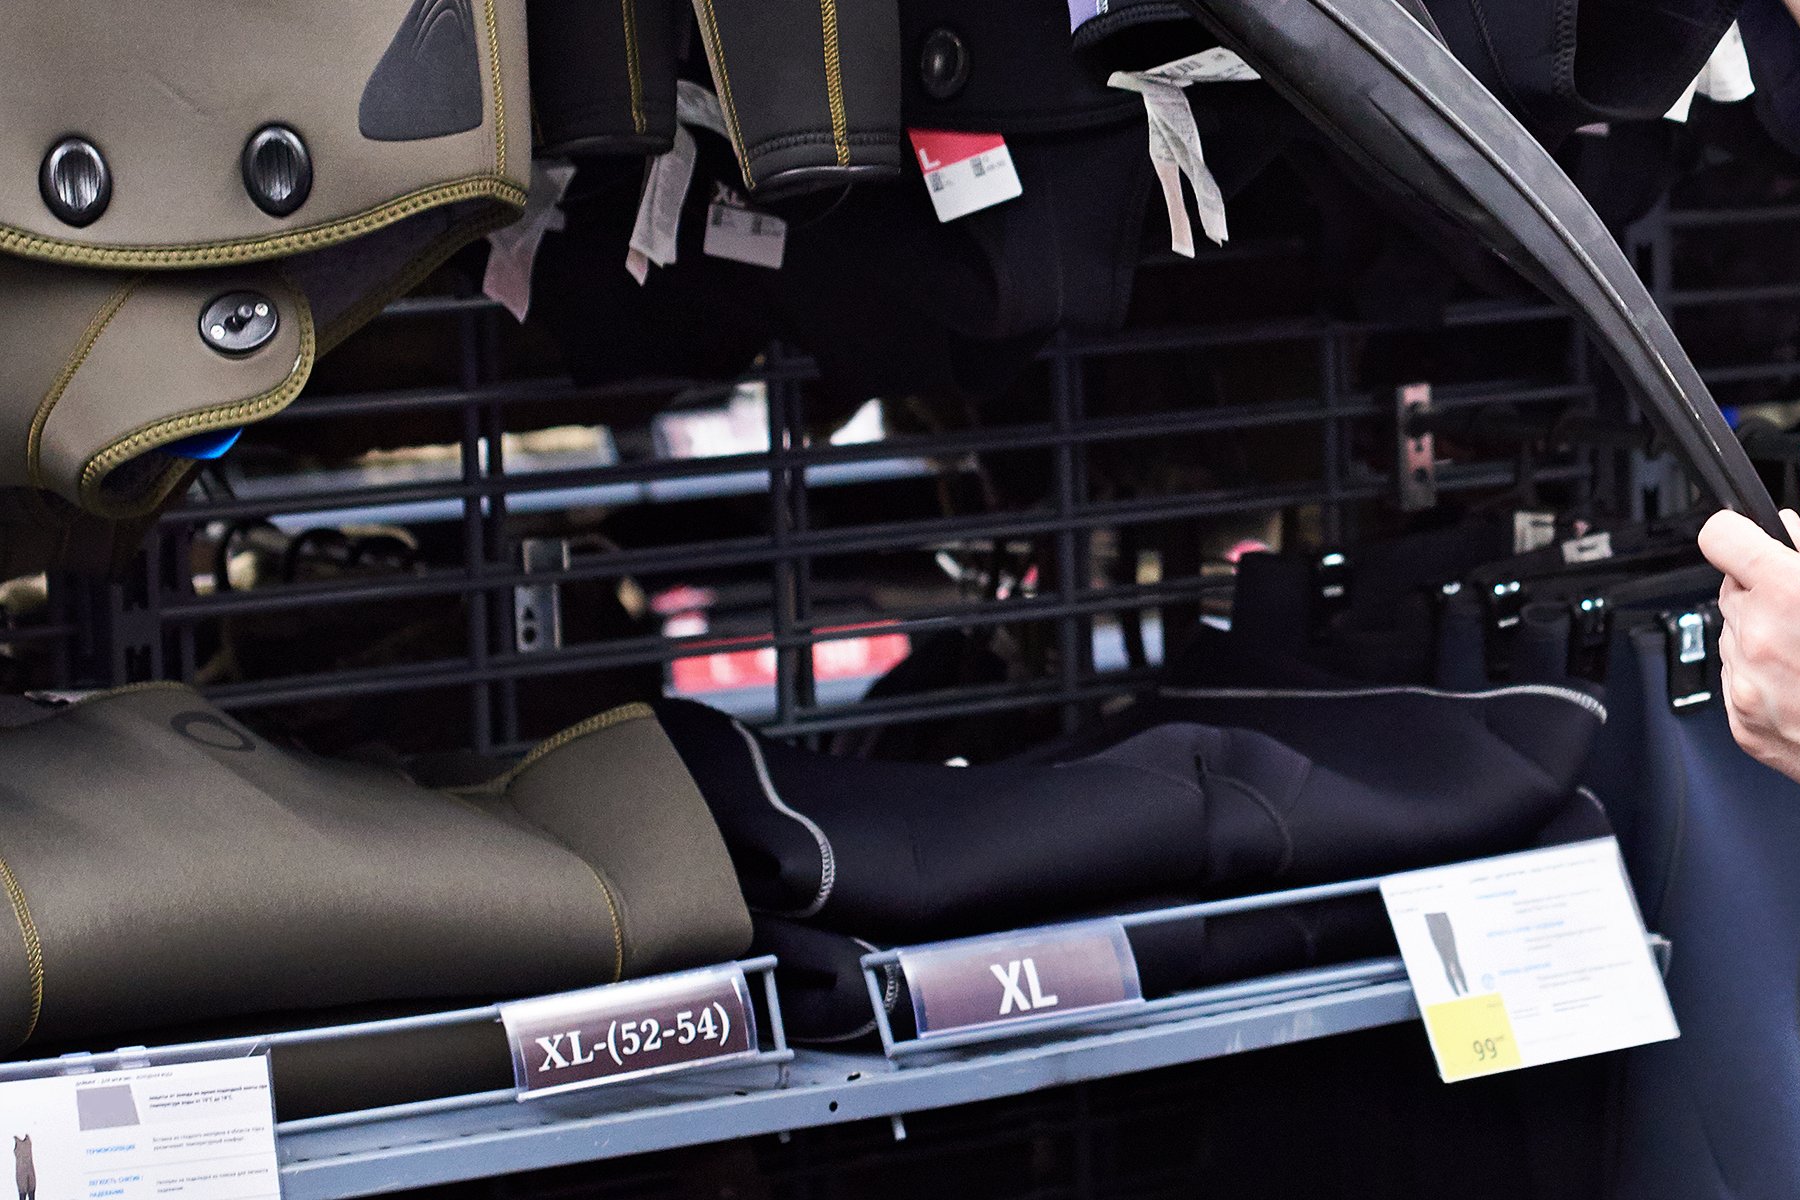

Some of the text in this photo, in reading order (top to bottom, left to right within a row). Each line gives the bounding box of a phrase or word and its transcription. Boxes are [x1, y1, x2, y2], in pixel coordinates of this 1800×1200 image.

[918, 148, 941, 170] L
[991, 958, 1057, 1015] XL
[535, 1001, 731, 1072] XL-(52-54)
[1472, 1037, 1498, 1061] 99
